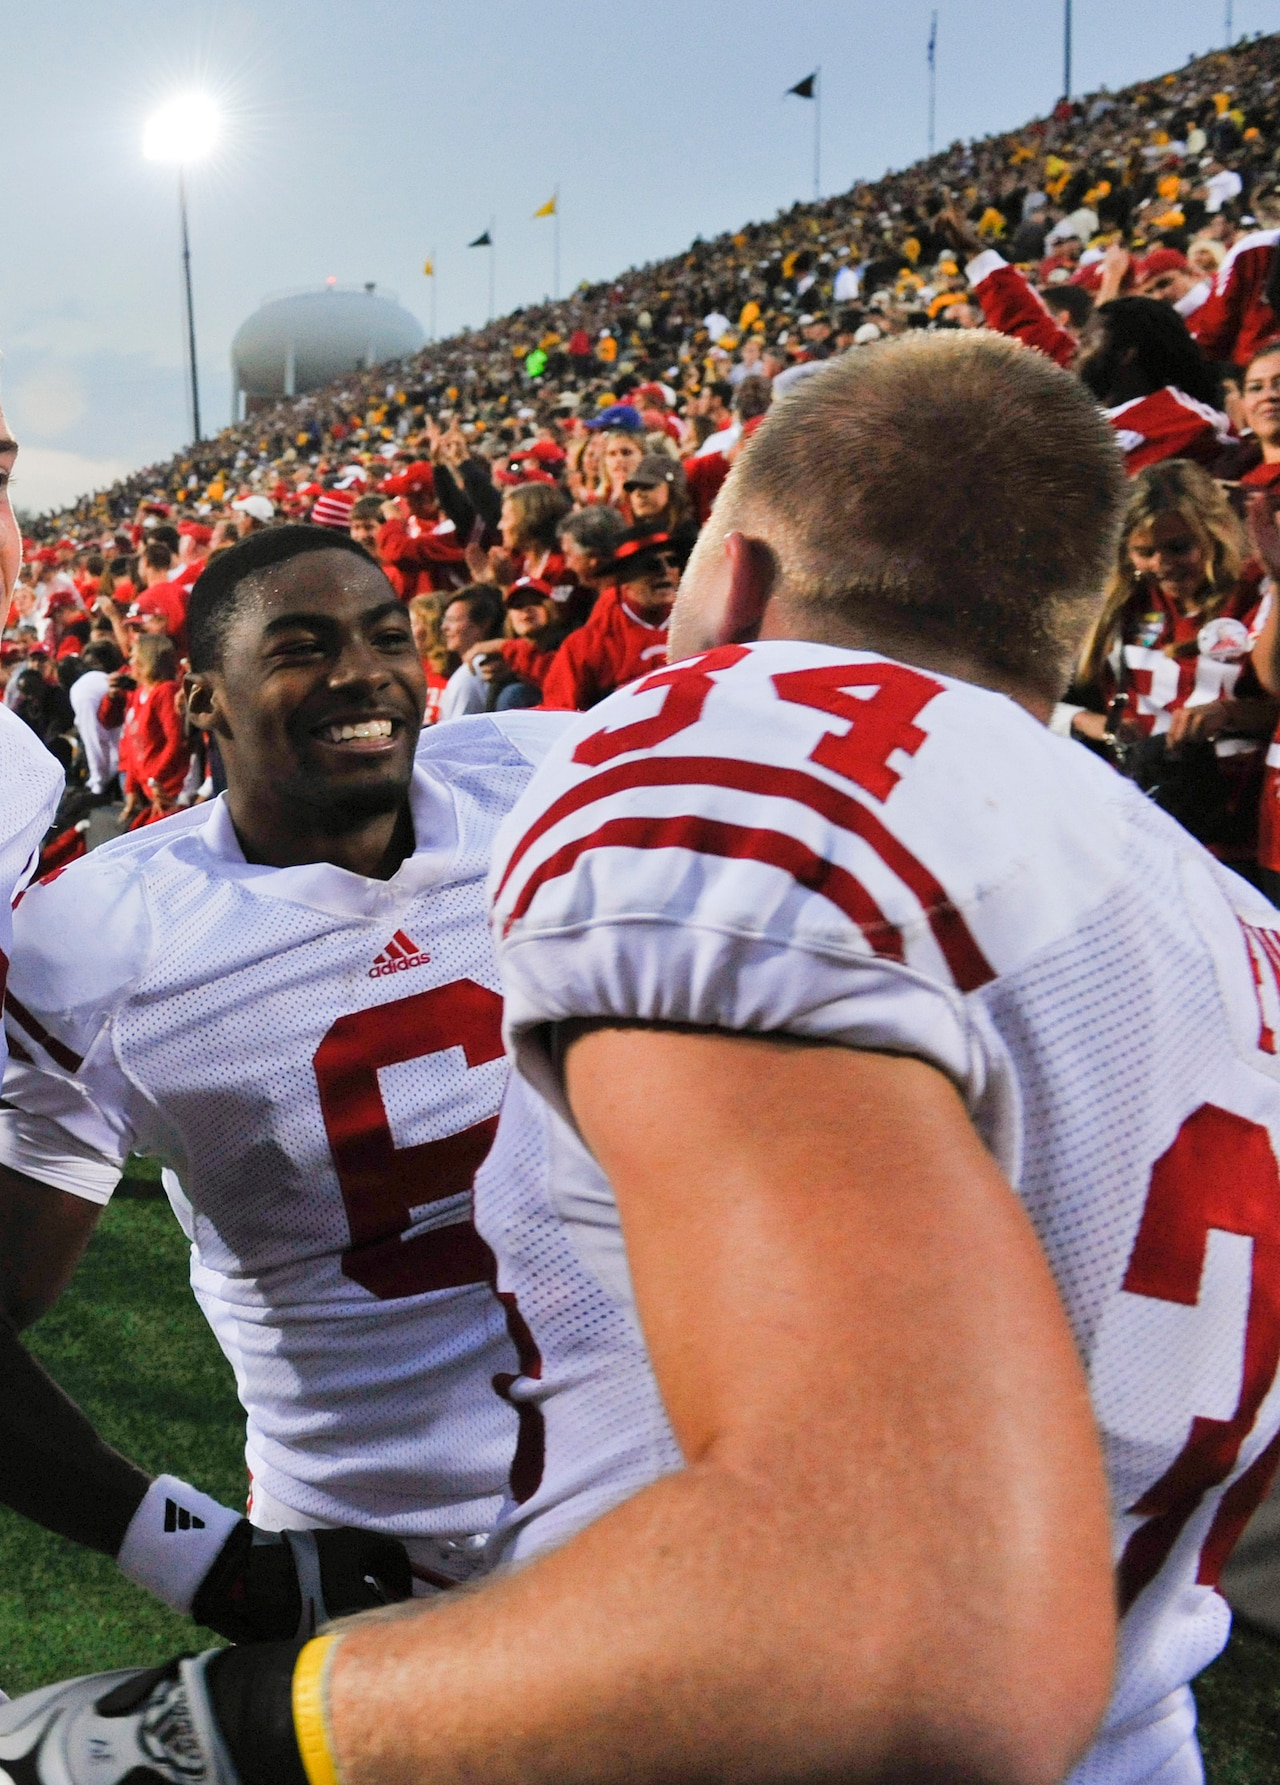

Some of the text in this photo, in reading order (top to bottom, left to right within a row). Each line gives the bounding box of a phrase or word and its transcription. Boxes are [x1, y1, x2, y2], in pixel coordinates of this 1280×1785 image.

[571, 643, 949, 803] 34
[368, 952, 432, 979] adidas
[312, 977, 504, 1300] 6
